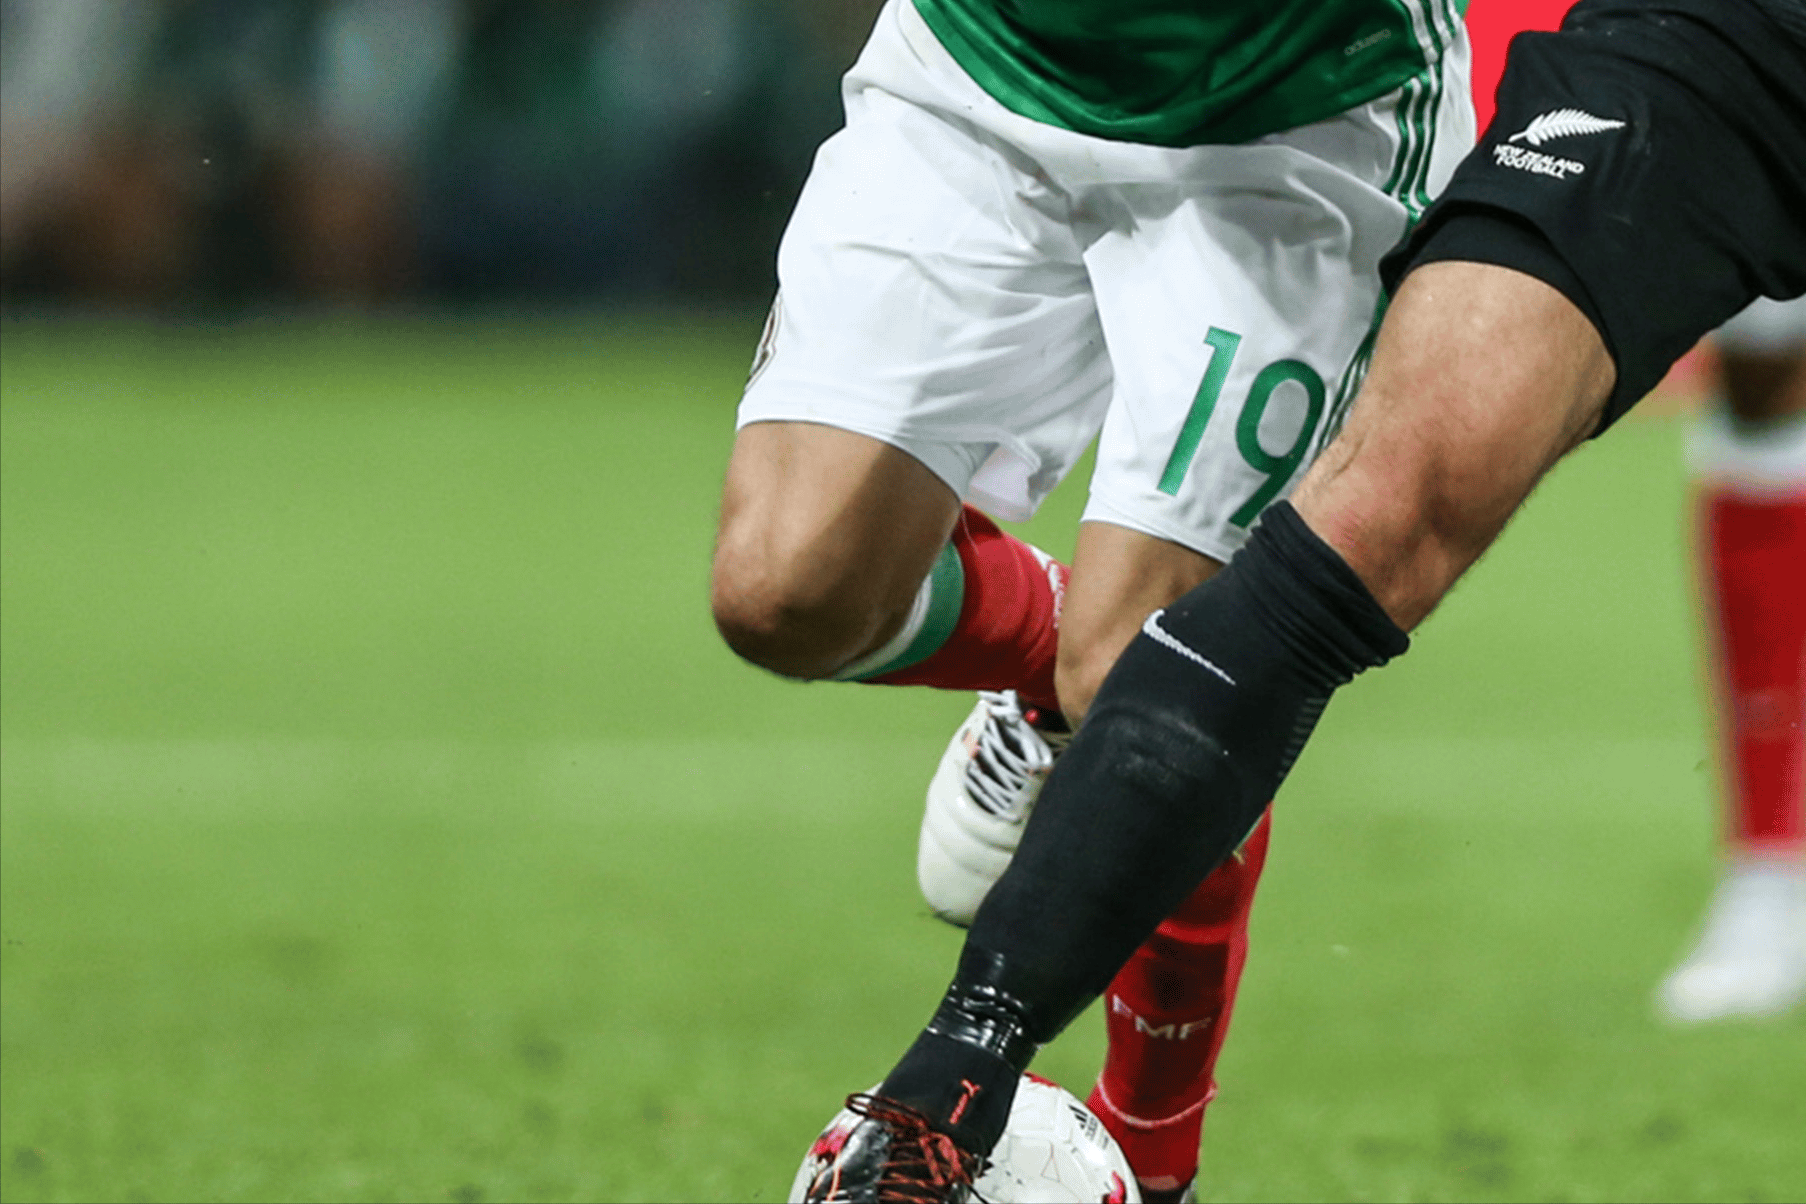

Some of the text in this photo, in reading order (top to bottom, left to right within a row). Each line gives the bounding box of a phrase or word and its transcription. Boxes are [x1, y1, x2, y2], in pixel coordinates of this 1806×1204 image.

[1493, 143, 1585, 175] NEW ZEALAND
[1496, 155, 1566, 180] FOOTBALL
[1156, 325, 1327, 528] 19
